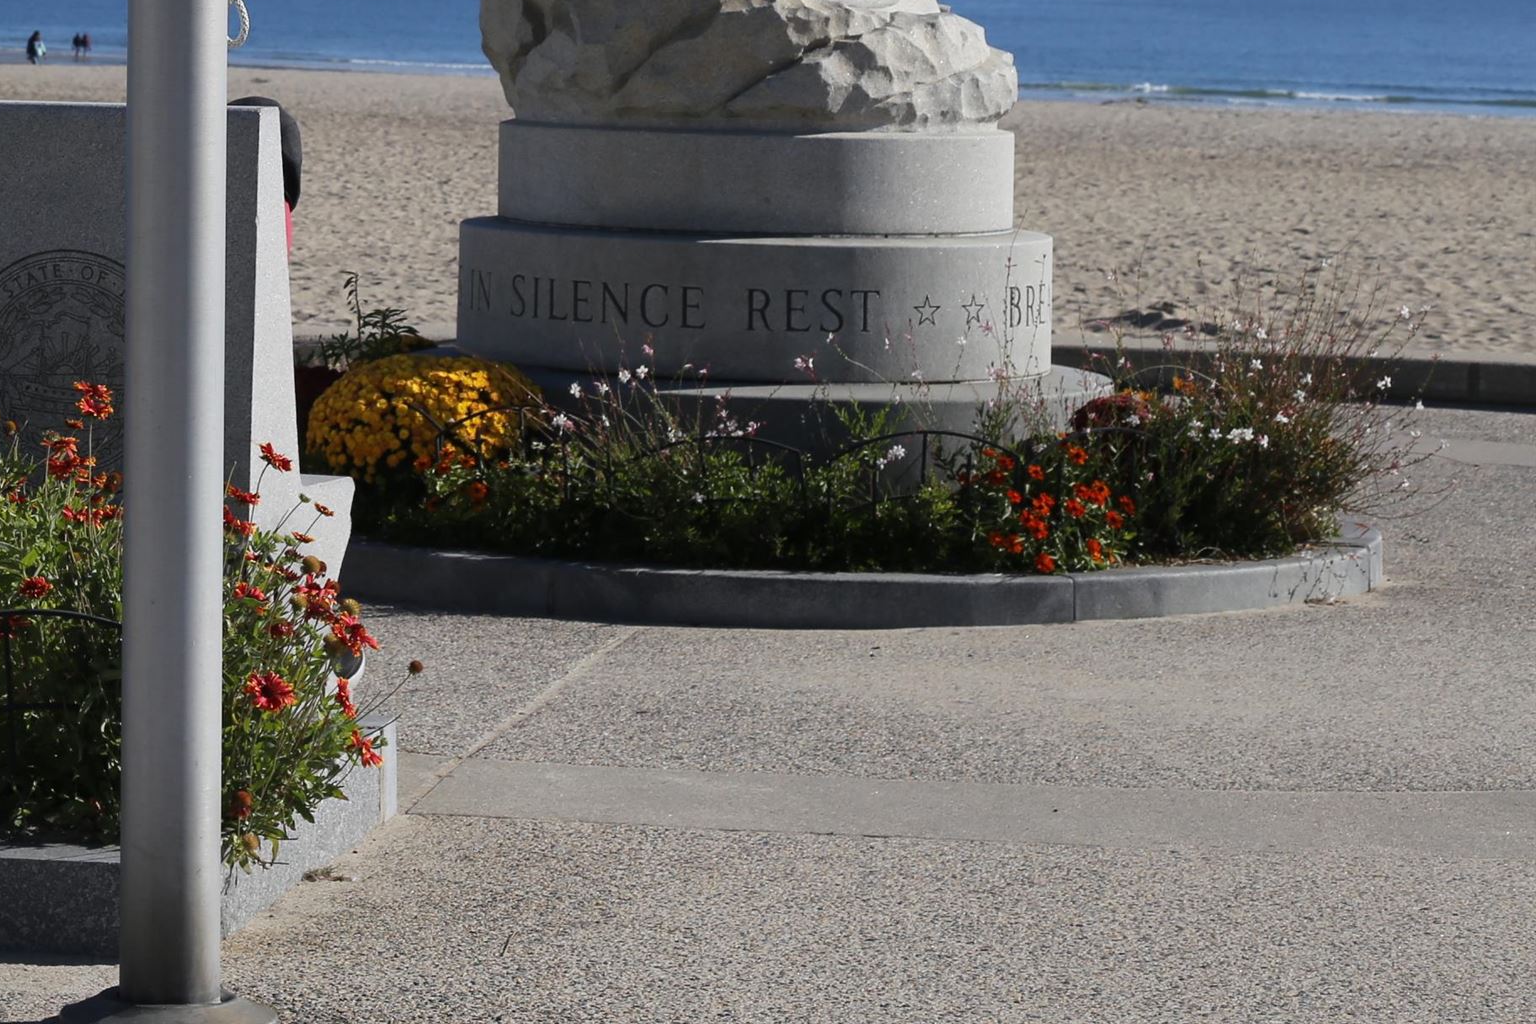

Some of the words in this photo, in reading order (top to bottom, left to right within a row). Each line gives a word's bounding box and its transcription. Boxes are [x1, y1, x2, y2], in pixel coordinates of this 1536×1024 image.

[1, 263, 64, 300] STATE
[79, 265, 111, 285] OF
[468, 268, 493, 312] IN
[509, 272, 707, 330] SILENCE
[745, 287, 882, 333] REST
